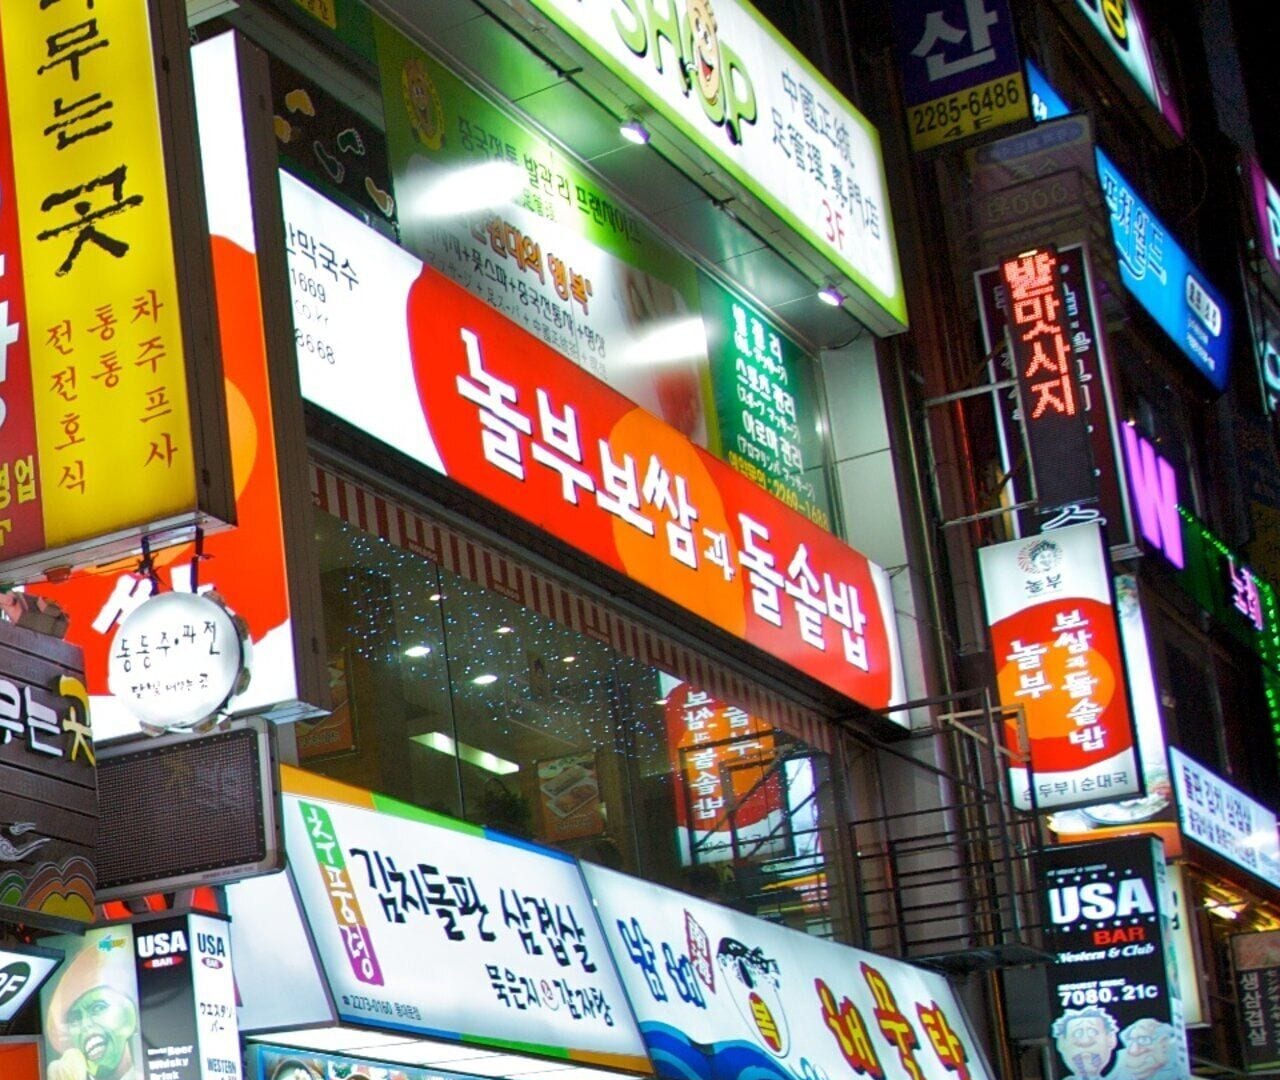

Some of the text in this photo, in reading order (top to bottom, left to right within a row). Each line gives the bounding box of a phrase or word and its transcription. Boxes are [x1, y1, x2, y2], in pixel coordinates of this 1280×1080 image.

[914, 86, 1021, 135] 2285-6486
[942, 117, 993, 140] 4F
[820, 198, 846, 251] 3F
[1003, 248, 1077, 420] 발맛사지
[737, 511, 870, 673] 돌솥밥
[1006, 640, 1054, 699] 놀부
[1080, 770, 1130, 794] 순대국
[1048, 877, 1156, 926] USA
[136, 929, 188, 958] USA
[197, 932, 226, 958] USA
[499, 887, 597, 974] 삼겹살
[1092, 925, 1146, 946] BAR
[151, 957, 173, 968] BAR
[1121, 942, 1155, 957] Club
[484, 963, 615, 1028] 묵은지 감자탕
[148, 1056, 189, 1071] Whisky
[207, 1057, 237, 1074] WESTERN
